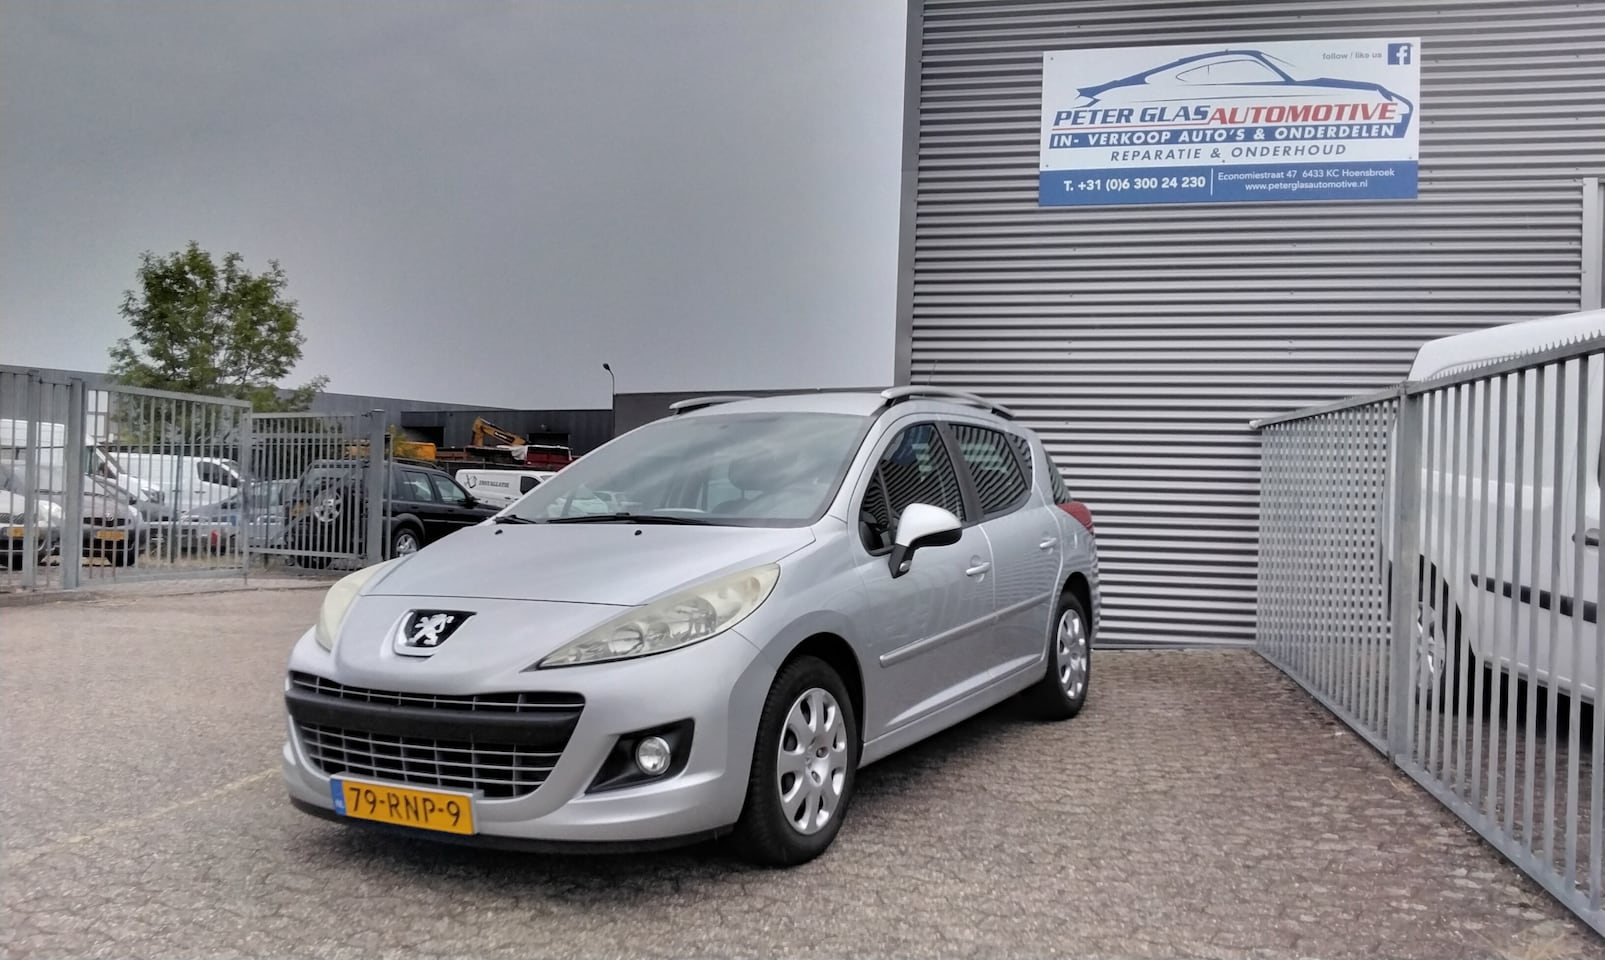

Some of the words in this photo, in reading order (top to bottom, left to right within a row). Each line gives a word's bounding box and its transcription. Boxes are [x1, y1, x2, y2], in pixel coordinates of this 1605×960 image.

[1053, 108, 1134, 126] PETER
[1053, 134, 1079, 147] IN-
[1087, 132, 1171, 145] VERKOOP
[1178, 128, 1246, 143] AUTO'S
[1253, 127, 1265, 140] &
[1275, 124, 1395, 139] ONDERDELEN
[1110, 148, 1201, 162] REPARATIE
[1210, 147, 1221, 159] &
[1231, 144, 1346, 158] ONDERHOUD
[1217, 171, 1284, 181] Economiestraat
[1286, 170, 1297, 178] 47
[1302, 169, 1324, 178] 6433
[1326, 169, 1340, 177] KC
[1342, 168, 1396, 177] Hoensbroek
[1063, 180, 1074, 191] T.
[1077, 180, 1101, 191] +31
[1105, 178, 1130, 192] (0)6
[1133, 178, 1158, 189] 300
[1161, 177, 1178, 188] 24
[1181, 176, 1206, 188] 230
[1245, 179, 1369, 191] www.peterglasautomotive.nl
[349, 787, 461, 827] 79-RNP-9
